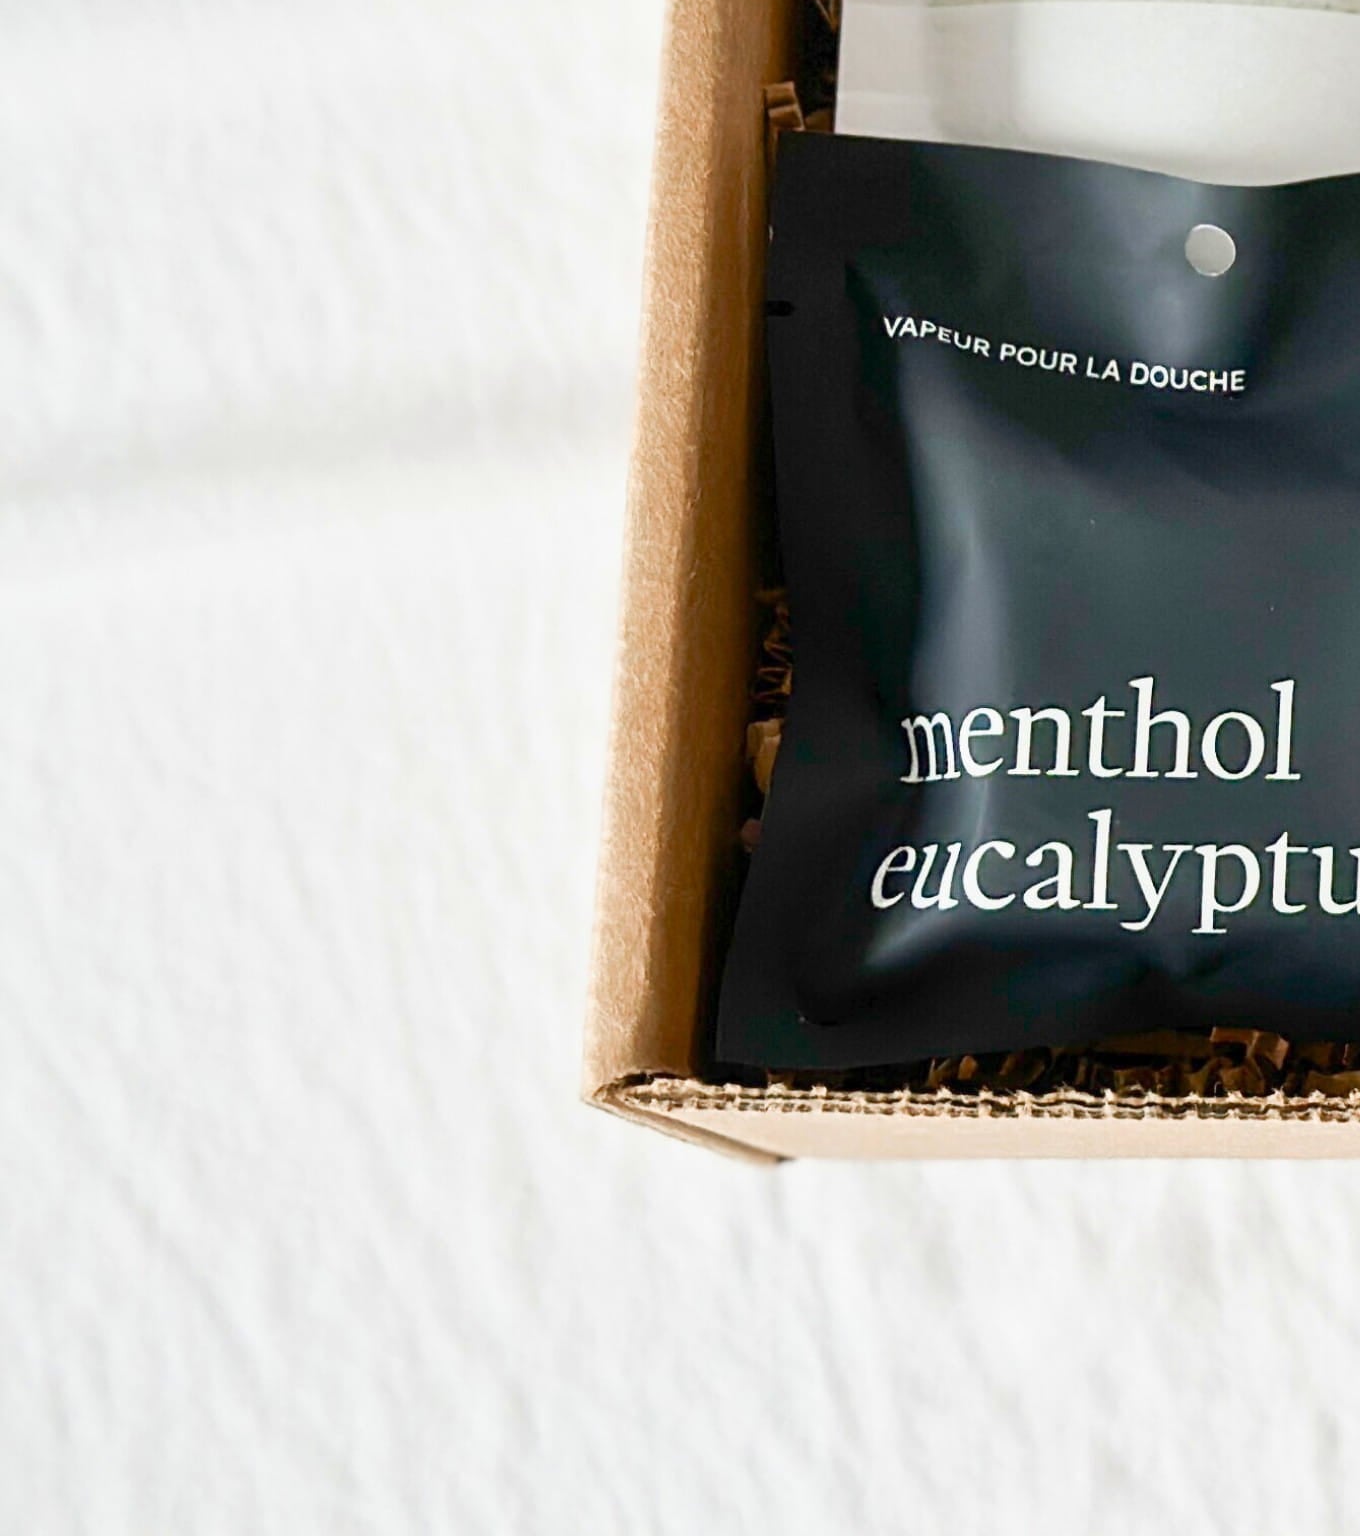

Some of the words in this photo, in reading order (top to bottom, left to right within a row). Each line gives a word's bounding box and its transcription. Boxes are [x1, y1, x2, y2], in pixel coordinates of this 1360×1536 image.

[883, 316, 991, 358] VAPEUR
[999, 342, 1078, 375] POUR
[1085, 356, 1121, 382] LA
[1129, 360, 1247, 393] DOUCHE
[899, 676, 1302, 784] menthol
